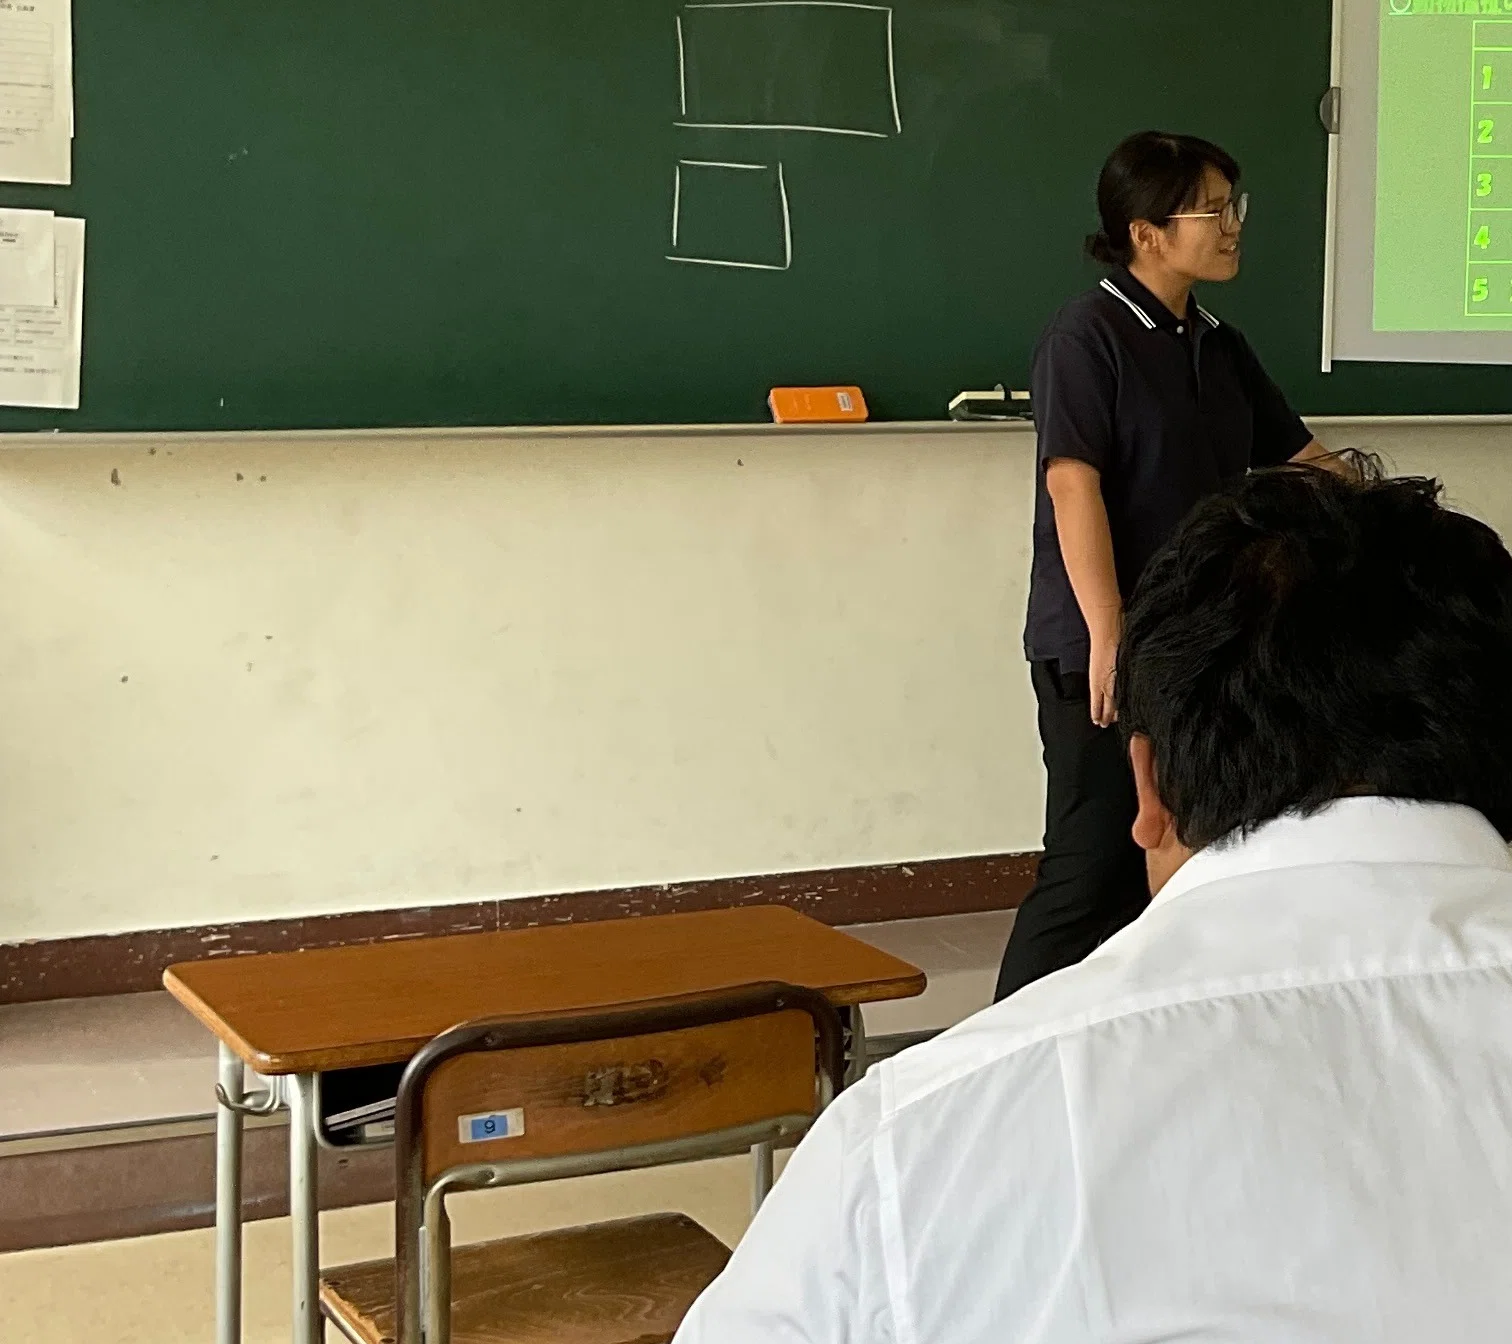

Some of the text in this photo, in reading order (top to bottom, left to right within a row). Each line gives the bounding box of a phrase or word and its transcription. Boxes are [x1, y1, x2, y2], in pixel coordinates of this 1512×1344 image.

[1481, 65, 1493, 89] 1
[1477, 119, 1493, 143] 2
[1475, 173, 1492, 197] 3
[1474, 225, 1490, 250] 4
[1472, 278, 1489, 303] 5
[484, 1119, 496, 1134] 9
